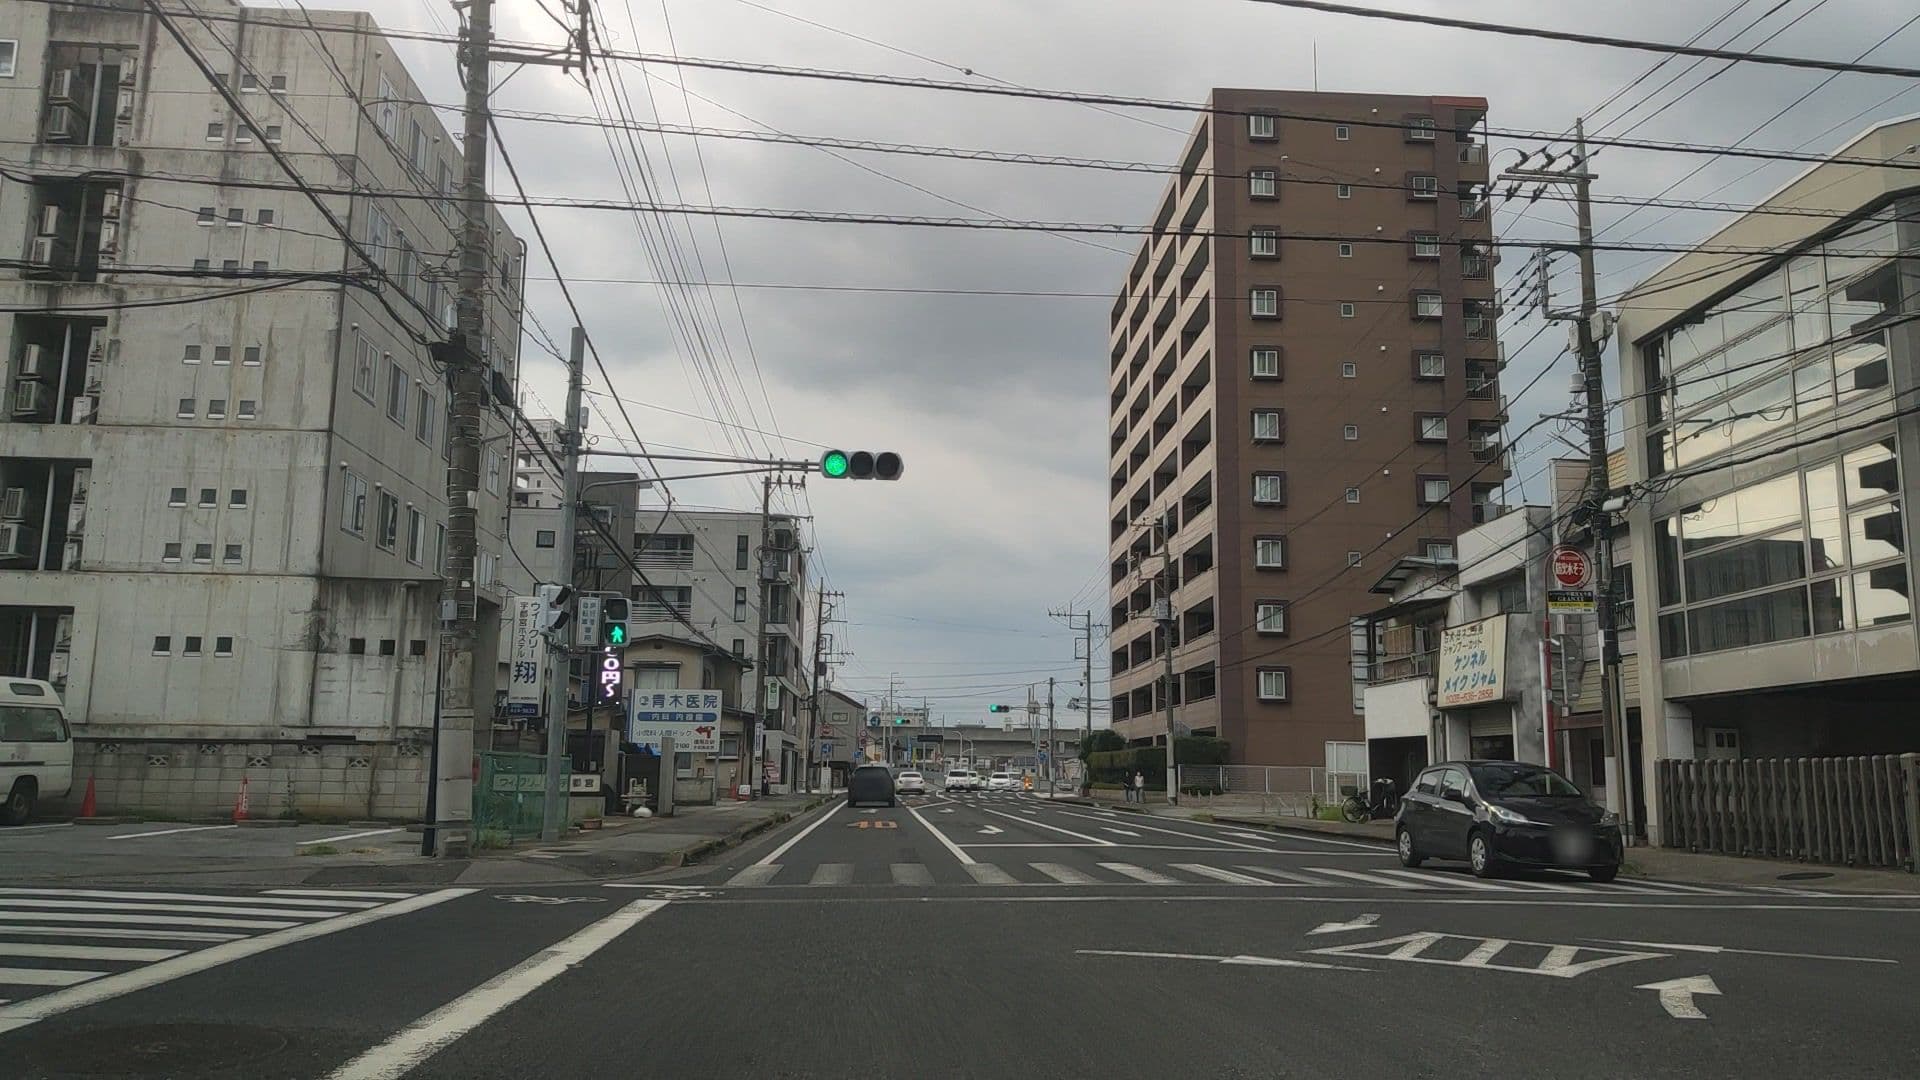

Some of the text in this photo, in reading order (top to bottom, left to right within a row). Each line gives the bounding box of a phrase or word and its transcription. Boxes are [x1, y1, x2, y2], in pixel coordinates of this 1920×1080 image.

[516, 601, 529, 658] 宇都宮ホステル
[528, 601, 541, 658] ウィークリー
[513, 661, 537, 684] 翔
[651, 694, 718, 709] 青木医院
